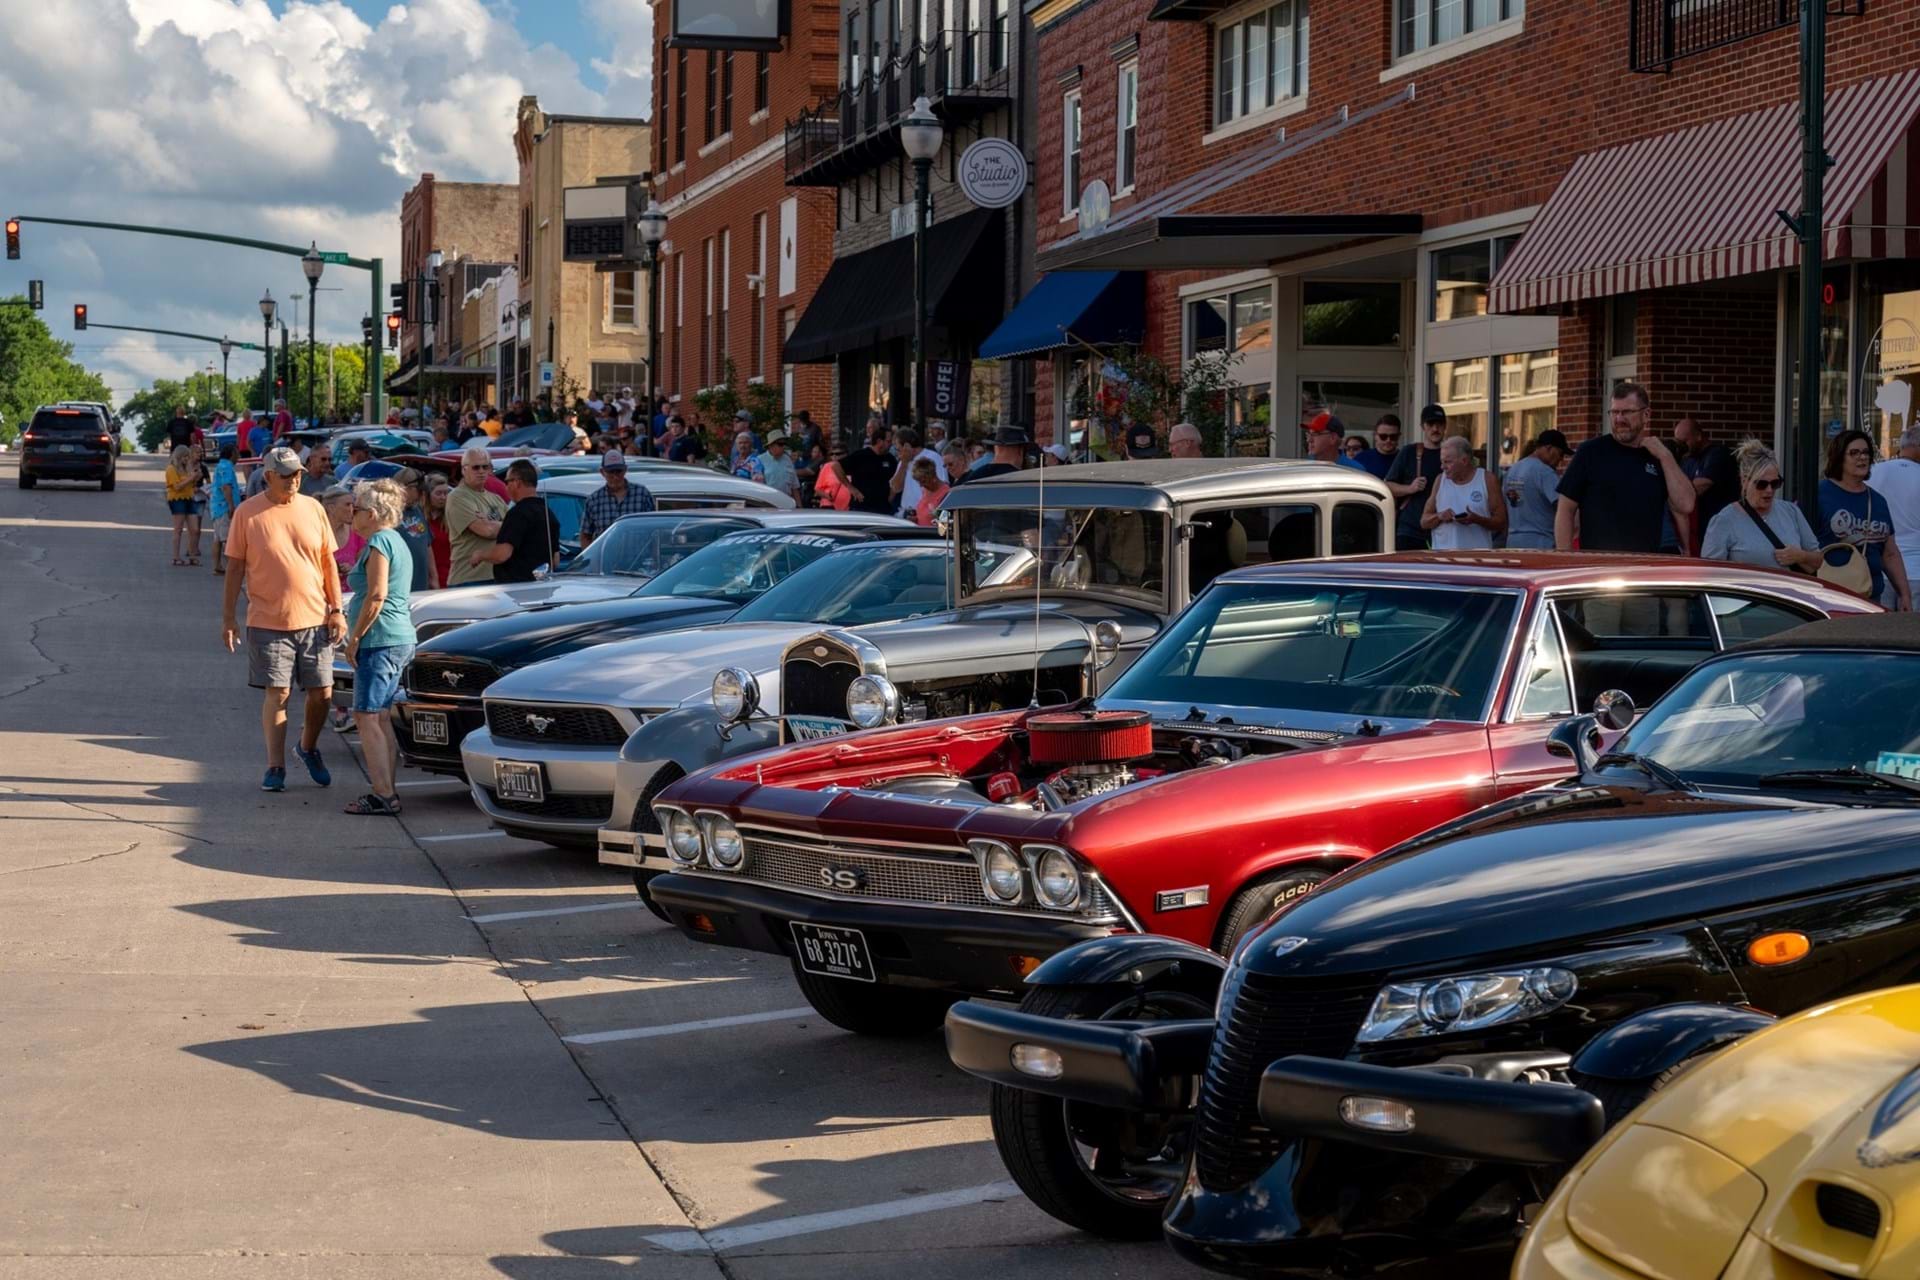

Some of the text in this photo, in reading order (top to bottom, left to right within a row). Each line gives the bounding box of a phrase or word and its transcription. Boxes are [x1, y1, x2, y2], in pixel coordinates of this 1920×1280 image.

[984, 157, 1001, 165] THE
[968, 163, 1018, 183] Studio
[1830, 509, 1889, 538] Queen
[820, 867, 857, 889] SS
[804, 937, 862, 969] 68 327C
